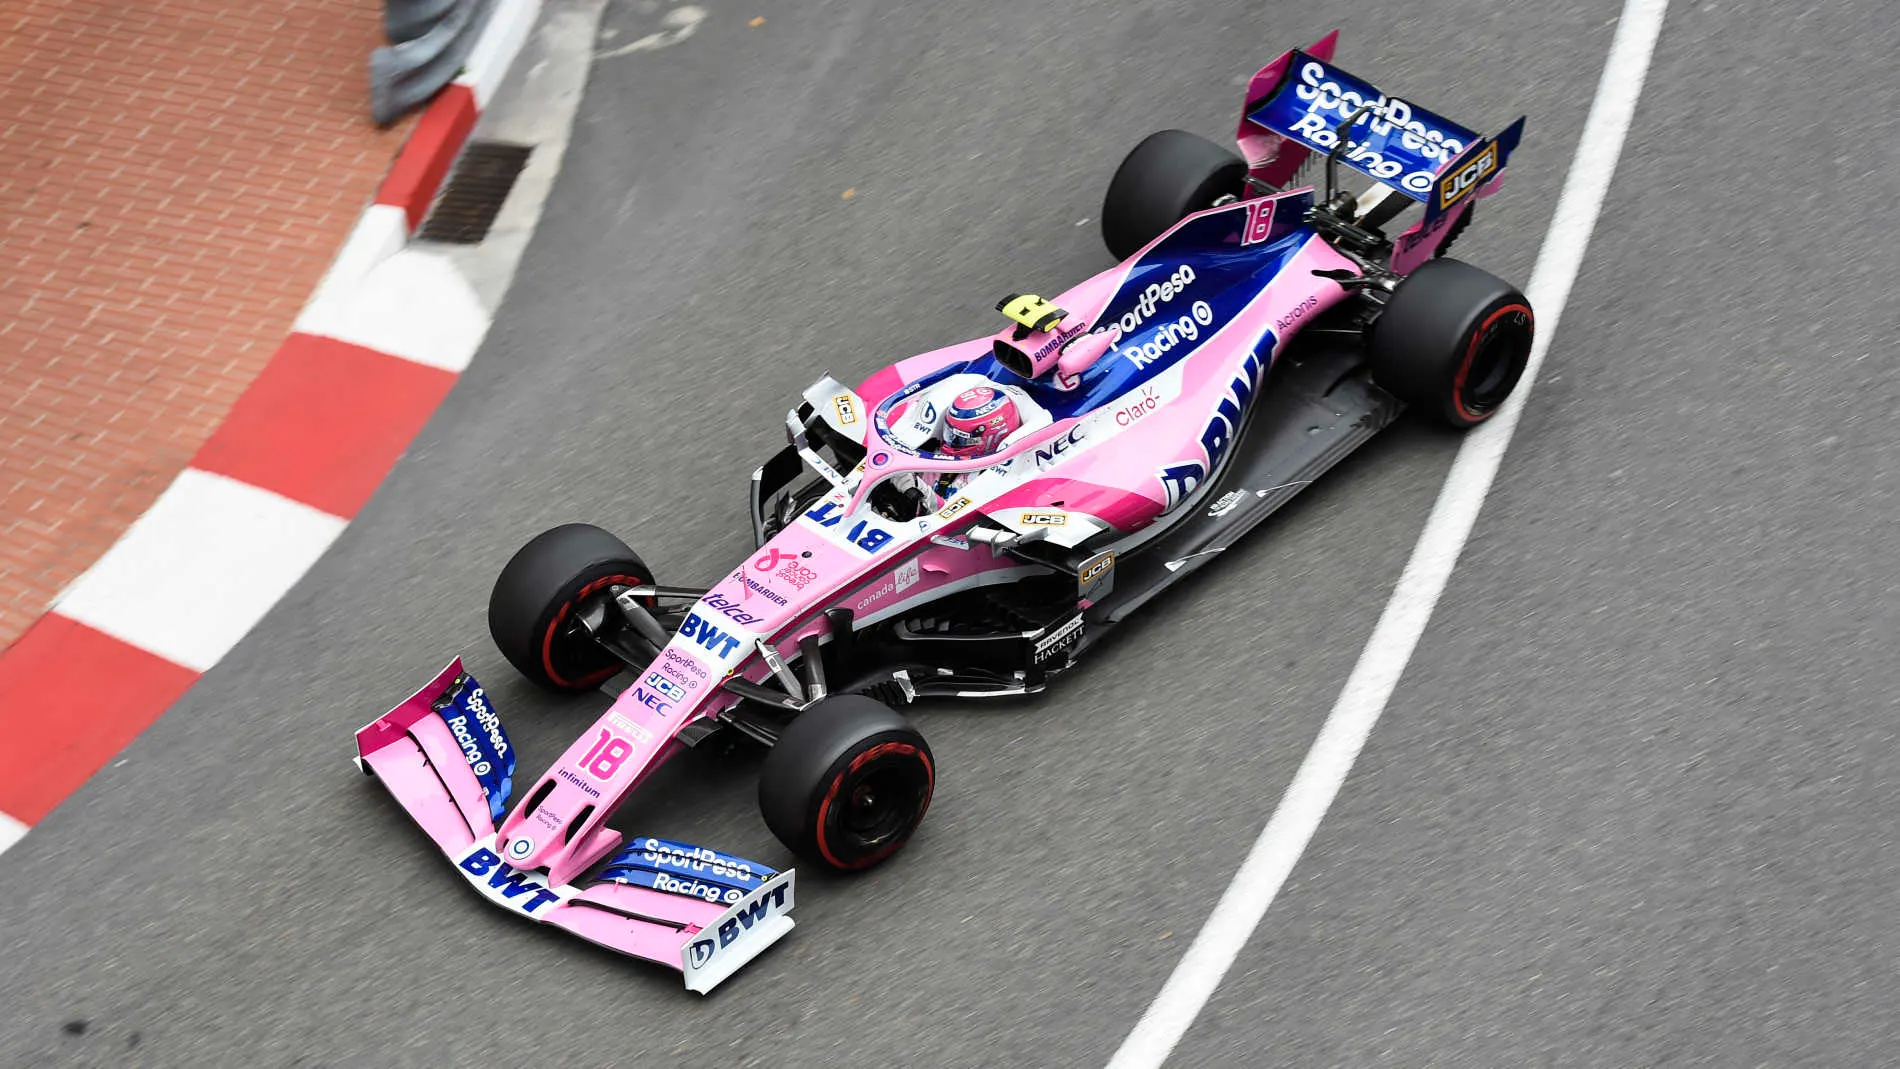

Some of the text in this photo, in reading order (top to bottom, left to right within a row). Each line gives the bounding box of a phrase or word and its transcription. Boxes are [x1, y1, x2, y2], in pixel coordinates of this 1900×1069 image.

[1296, 62, 1463, 165] SportPesa
[1288, 112, 1402, 178] Raing
[1445, 151, 1493, 200] JCB
[1240, 199, 1277, 246] 18
[1277, 296, 1318, 331] Acronis
[1122, 315, 1198, 370] Racing
[837, 396, 855, 424] JCB
[914, 422, 931, 435] BWT
[1116, 396, 1157, 427] Claro
[1035, 424, 1084, 466] NEC
[1022, 515, 1066, 525] JCB
[857, 567, 918, 610] canada life
[1084, 556, 1112, 581] JCB
[702, 593, 764, 625] telcel
[679, 612, 741, 659] BWT
[1034, 625, 1085, 665] HACKETT
[662, 663, 690, 685] Racing
[665, 649, 707, 679] SportPesa
[632, 687, 673, 717] NEC
[645, 672, 686, 702] JCB
[448, 715, 482, 763] Racing
[466, 688, 507, 759] SportPesa
[577, 727, 635, 780] 18
[558, 766, 601, 798] infinitum
[459, 847, 560, 913] BWT
[644, 838, 750, 882] SportPesa
[653, 872, 721, 903] Racing
[718, 881, 789, 950] BWT
